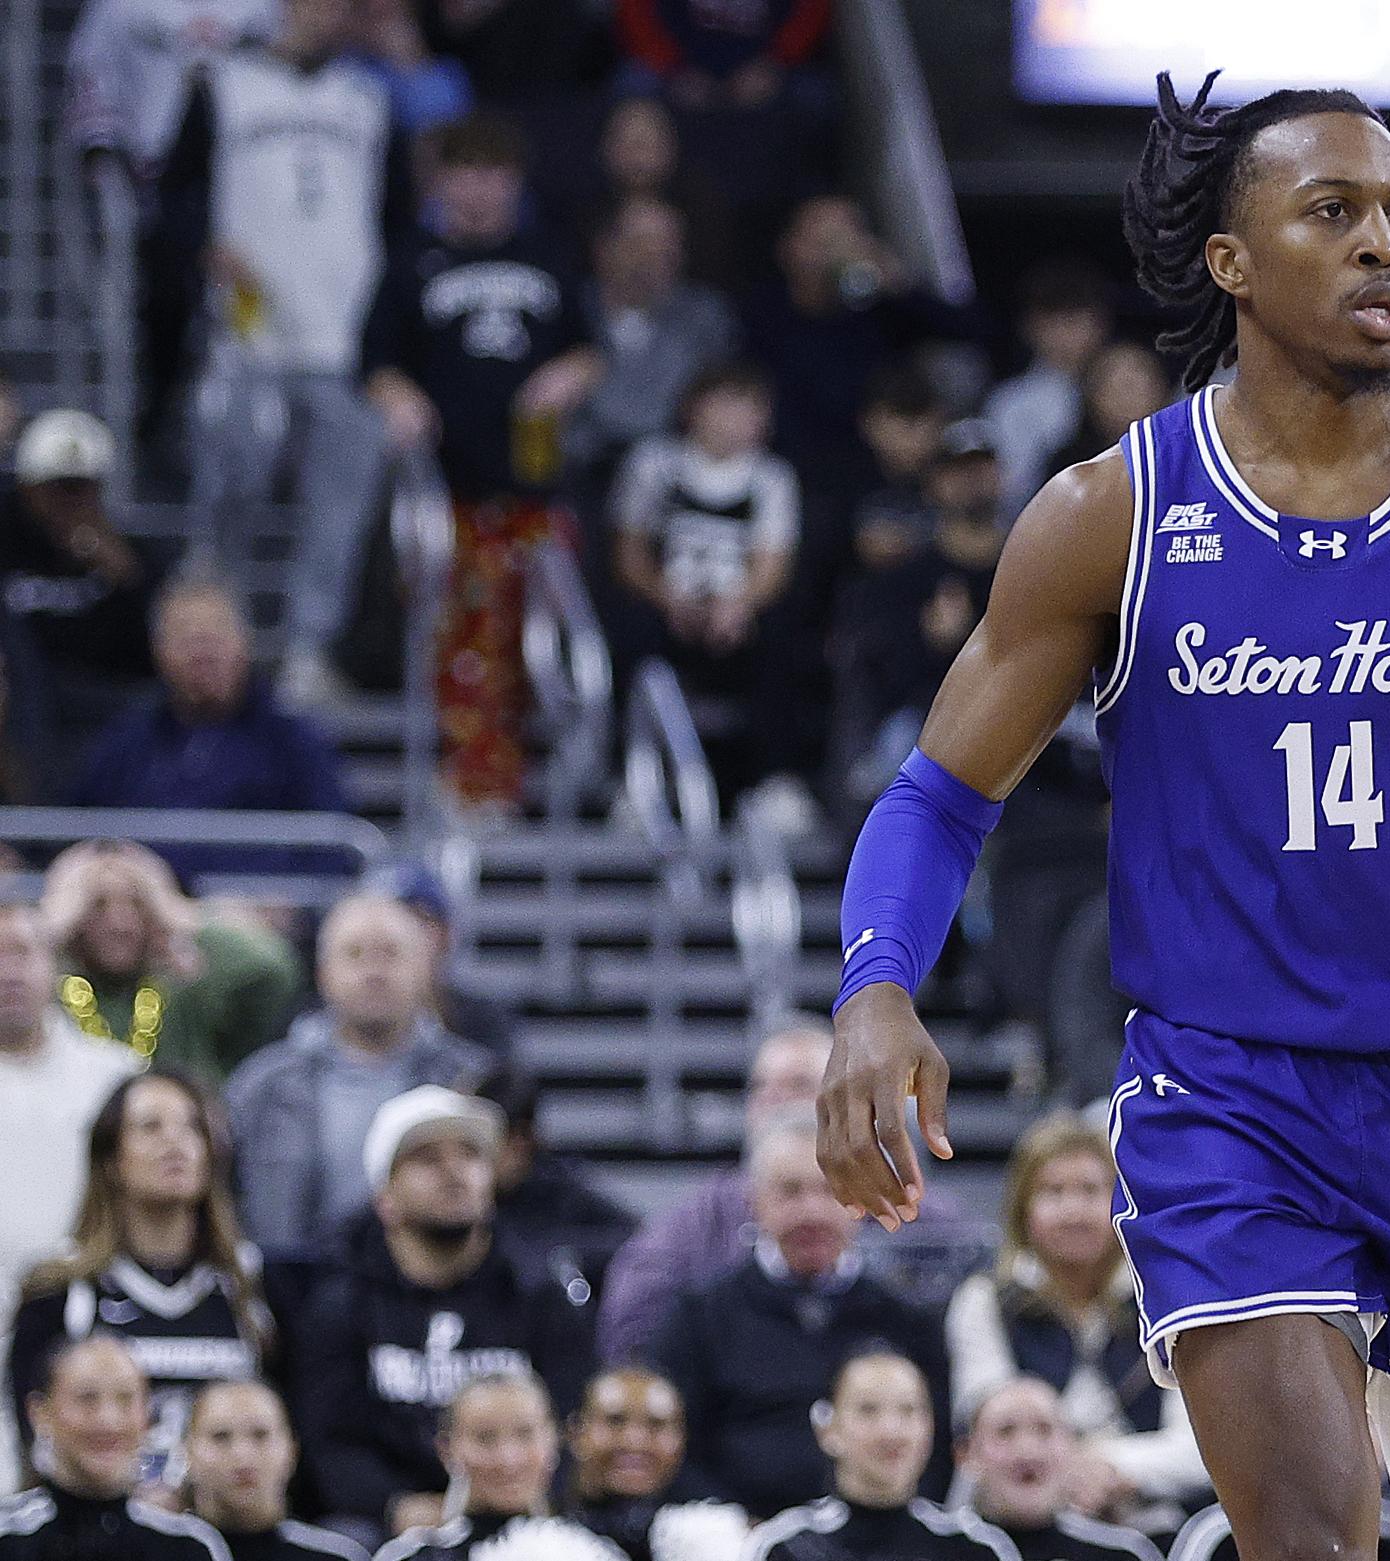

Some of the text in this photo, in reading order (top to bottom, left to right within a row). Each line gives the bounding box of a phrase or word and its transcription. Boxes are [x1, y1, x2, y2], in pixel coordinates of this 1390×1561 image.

[1166, 502, 1207, 517] BIG
[1160, 513, 1218, 527] EAST
[1171, 534, 1222, 550] BE THE
[1166, 547, 1224, 563] CHANGE
[1168, 622, 1321, 694] Seton
[1272, 720, 1384, 851] 14
